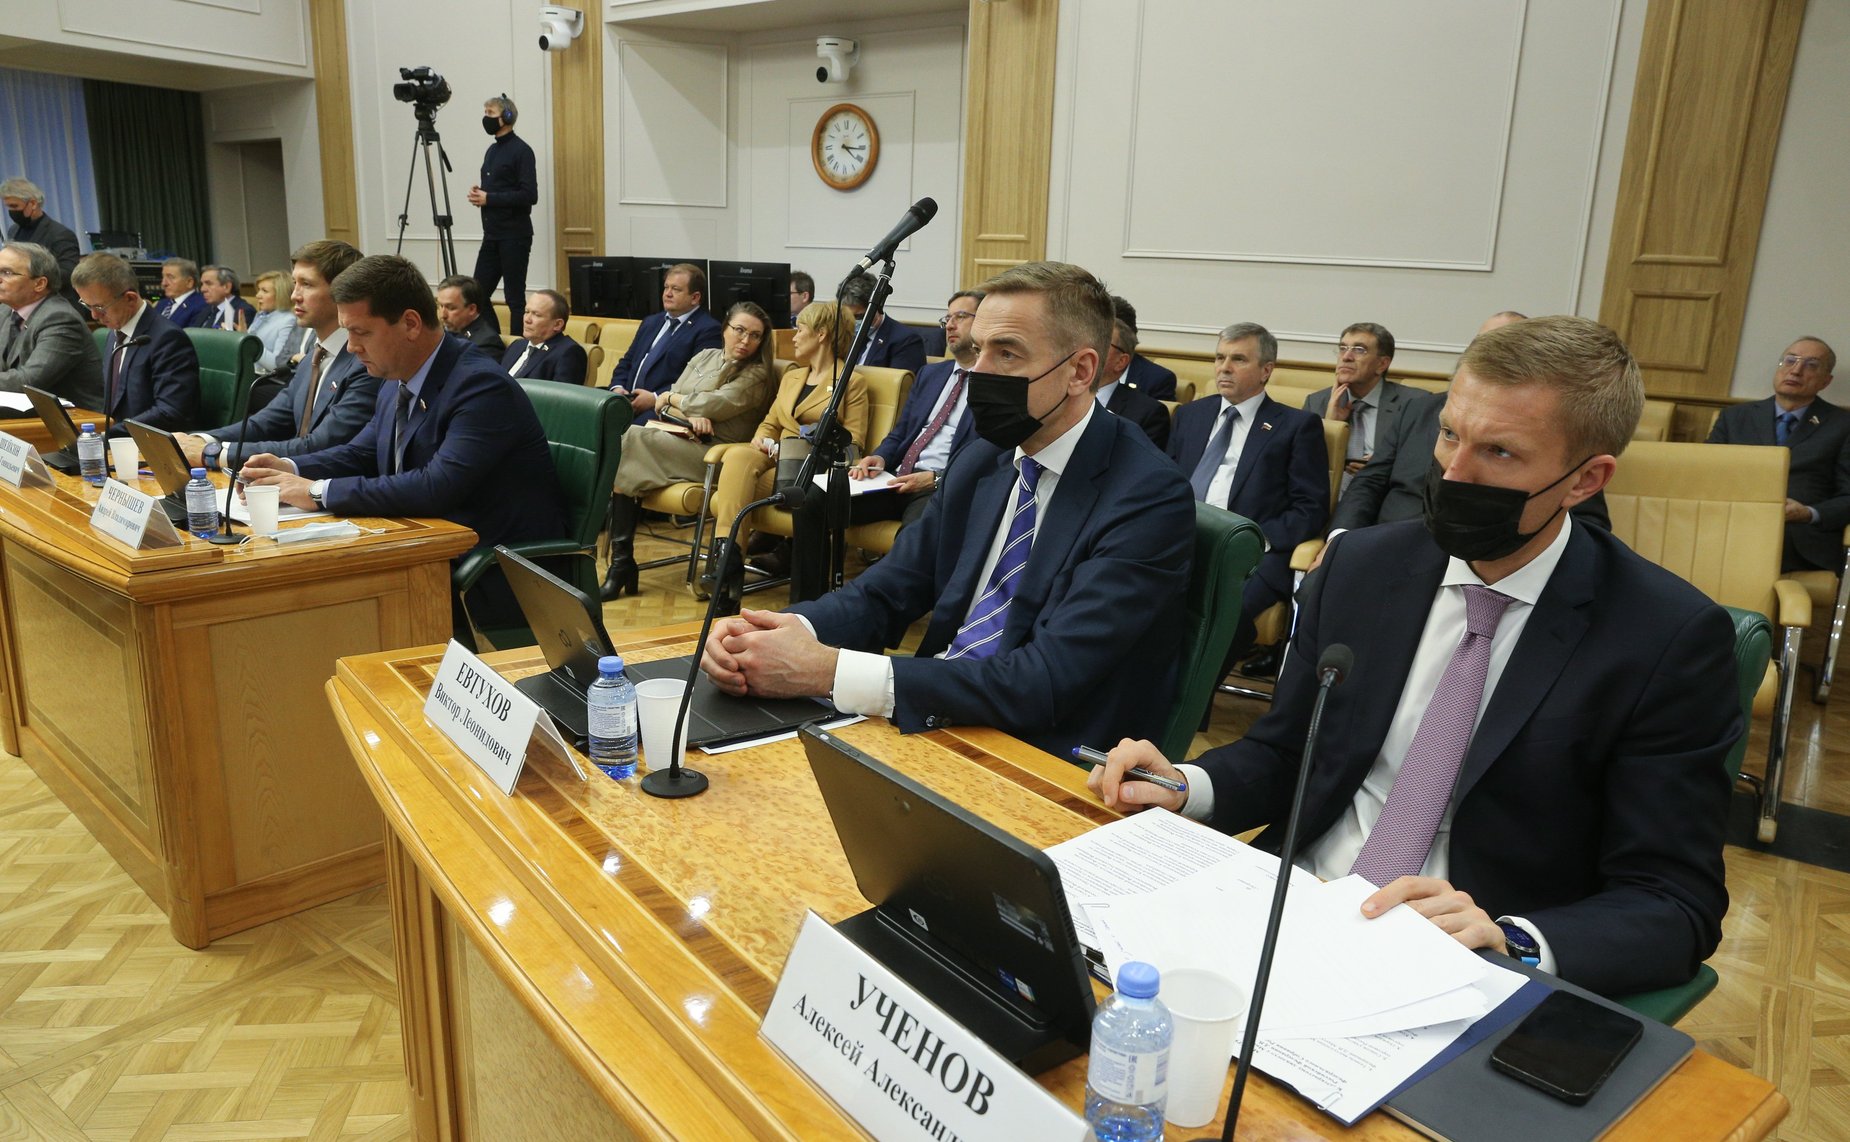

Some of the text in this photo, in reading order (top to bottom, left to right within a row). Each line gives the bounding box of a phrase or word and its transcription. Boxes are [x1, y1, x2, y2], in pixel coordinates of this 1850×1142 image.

[108, 486, 145, 514] ЧЕРНЫШЕВ
[434, 682, 512, 766] Виктор Леонидович
[456, 662, 512, 722] ЕВТУХОВ
[792, 993, 864, 1067] Алексей
[849, 972, 996, 1116] УЧЕНОВ
